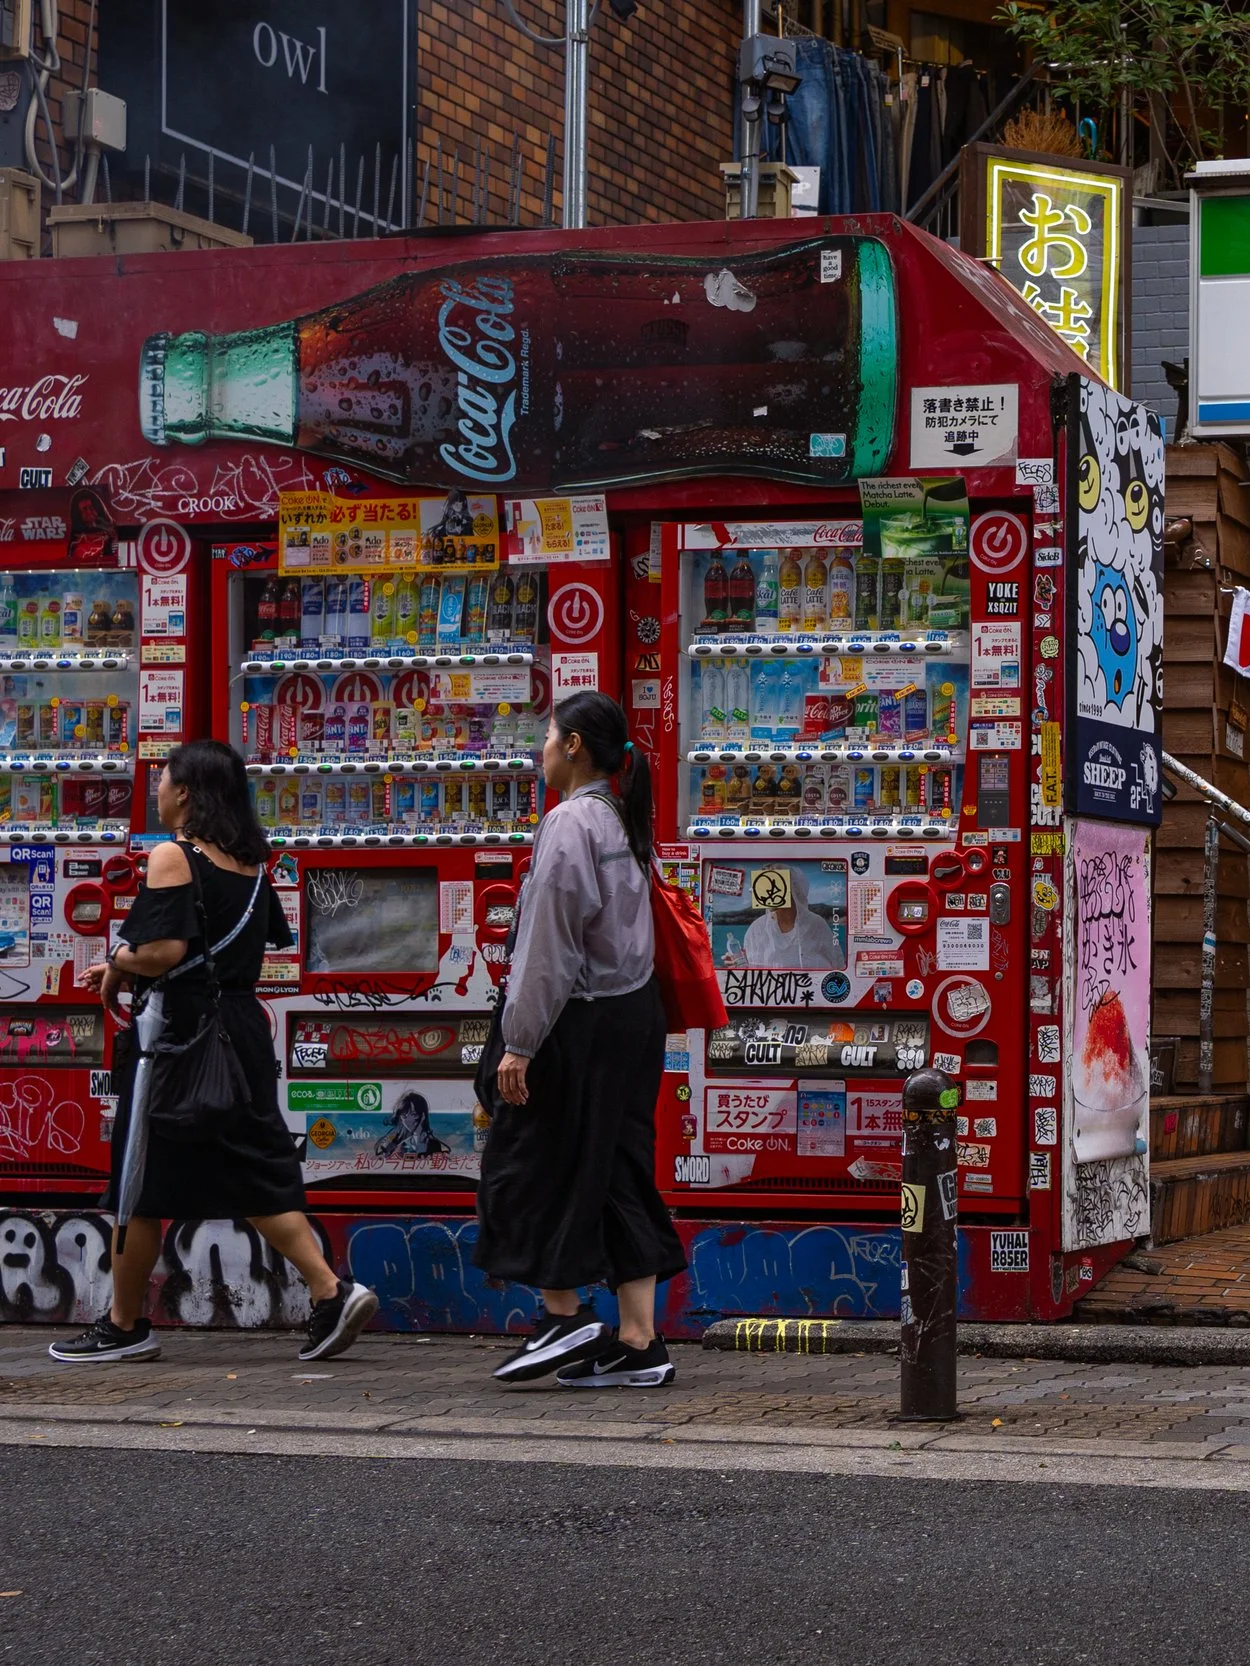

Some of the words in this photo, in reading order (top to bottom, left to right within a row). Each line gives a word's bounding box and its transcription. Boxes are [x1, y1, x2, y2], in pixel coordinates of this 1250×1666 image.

[253, 21, 329, 94] owl
[437, 275, 516, 482] Coca-Cola
[0, 374, 89, 421] ca-Cola
[925, 415, 999, 428] 防犯カメラにて
[944, 430, 979, 443] 追跡中
[22, 469, 51, 488] CULT
[878, 481, 902, 489] richest
[179, 496, 236, 514] CROOK
[21, 517, 66, 529] STAR
[281, 512, 327, 525] いずれか
[21, 528, 66, 540] WARS
[1037, 552, 1060, 562] SideB
[988, 583, 1019, 598] YOKE
[806, 596, 824, 604] LATTE
[988, 602, 1018, 614] XSQZIT
[1083, 761, 1126, 790] SHEEP
[1046, 771, 1057, 803] F.A.T.
[1130, 785, 1141, 809] 2F
[12, 849, 31, 860] QR
[31, 850, 54, 858] Scan!
[32, 897, 51, 907] QR
[32, 908, 51, 916] Scan!
[832, 908, 840, 946] LOHAS
[1031, 950, 1049, 959] SN
[1082, 924, 1137, 976] かき氷
[1031, 960, 1049, 969] AP
[746, 1043, 781, 1063] CULT
[841, 1046, 877, 1066] CULT
[91, 1072, 119, 1096] SWO
[717, 1094, 769, 1109] 買うたび
[716, 1109, 787, 1130] スタンプ
[726, 1138, 764, 1151] Coke
[675, 1157, 710, 1183] SWORD
[992, 1233, 1027, 1250] YUHAL
[992, 1250, 1027, 1266] R85ER
